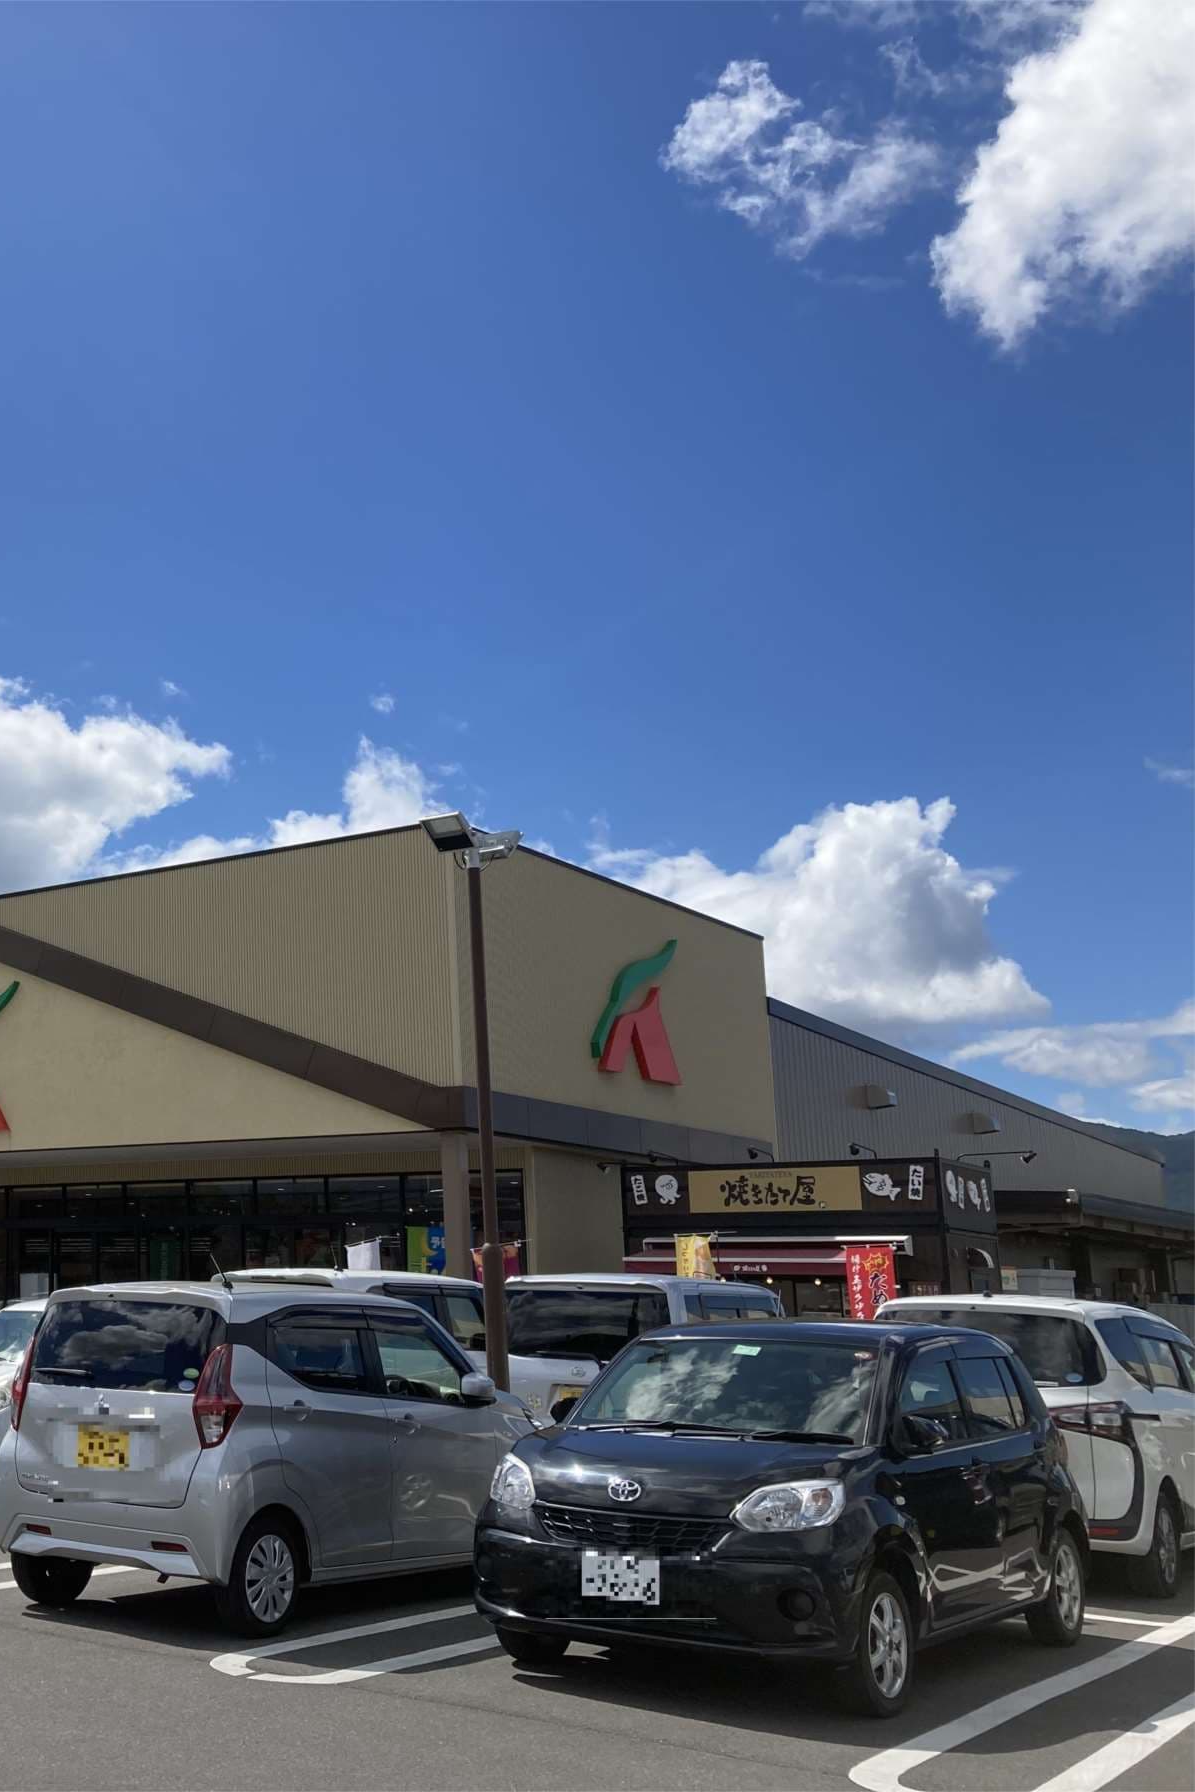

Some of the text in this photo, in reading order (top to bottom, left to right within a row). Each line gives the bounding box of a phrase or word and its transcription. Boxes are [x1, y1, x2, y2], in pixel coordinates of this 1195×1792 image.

[719, 1174, 817, 1207] 焼きたて屋
